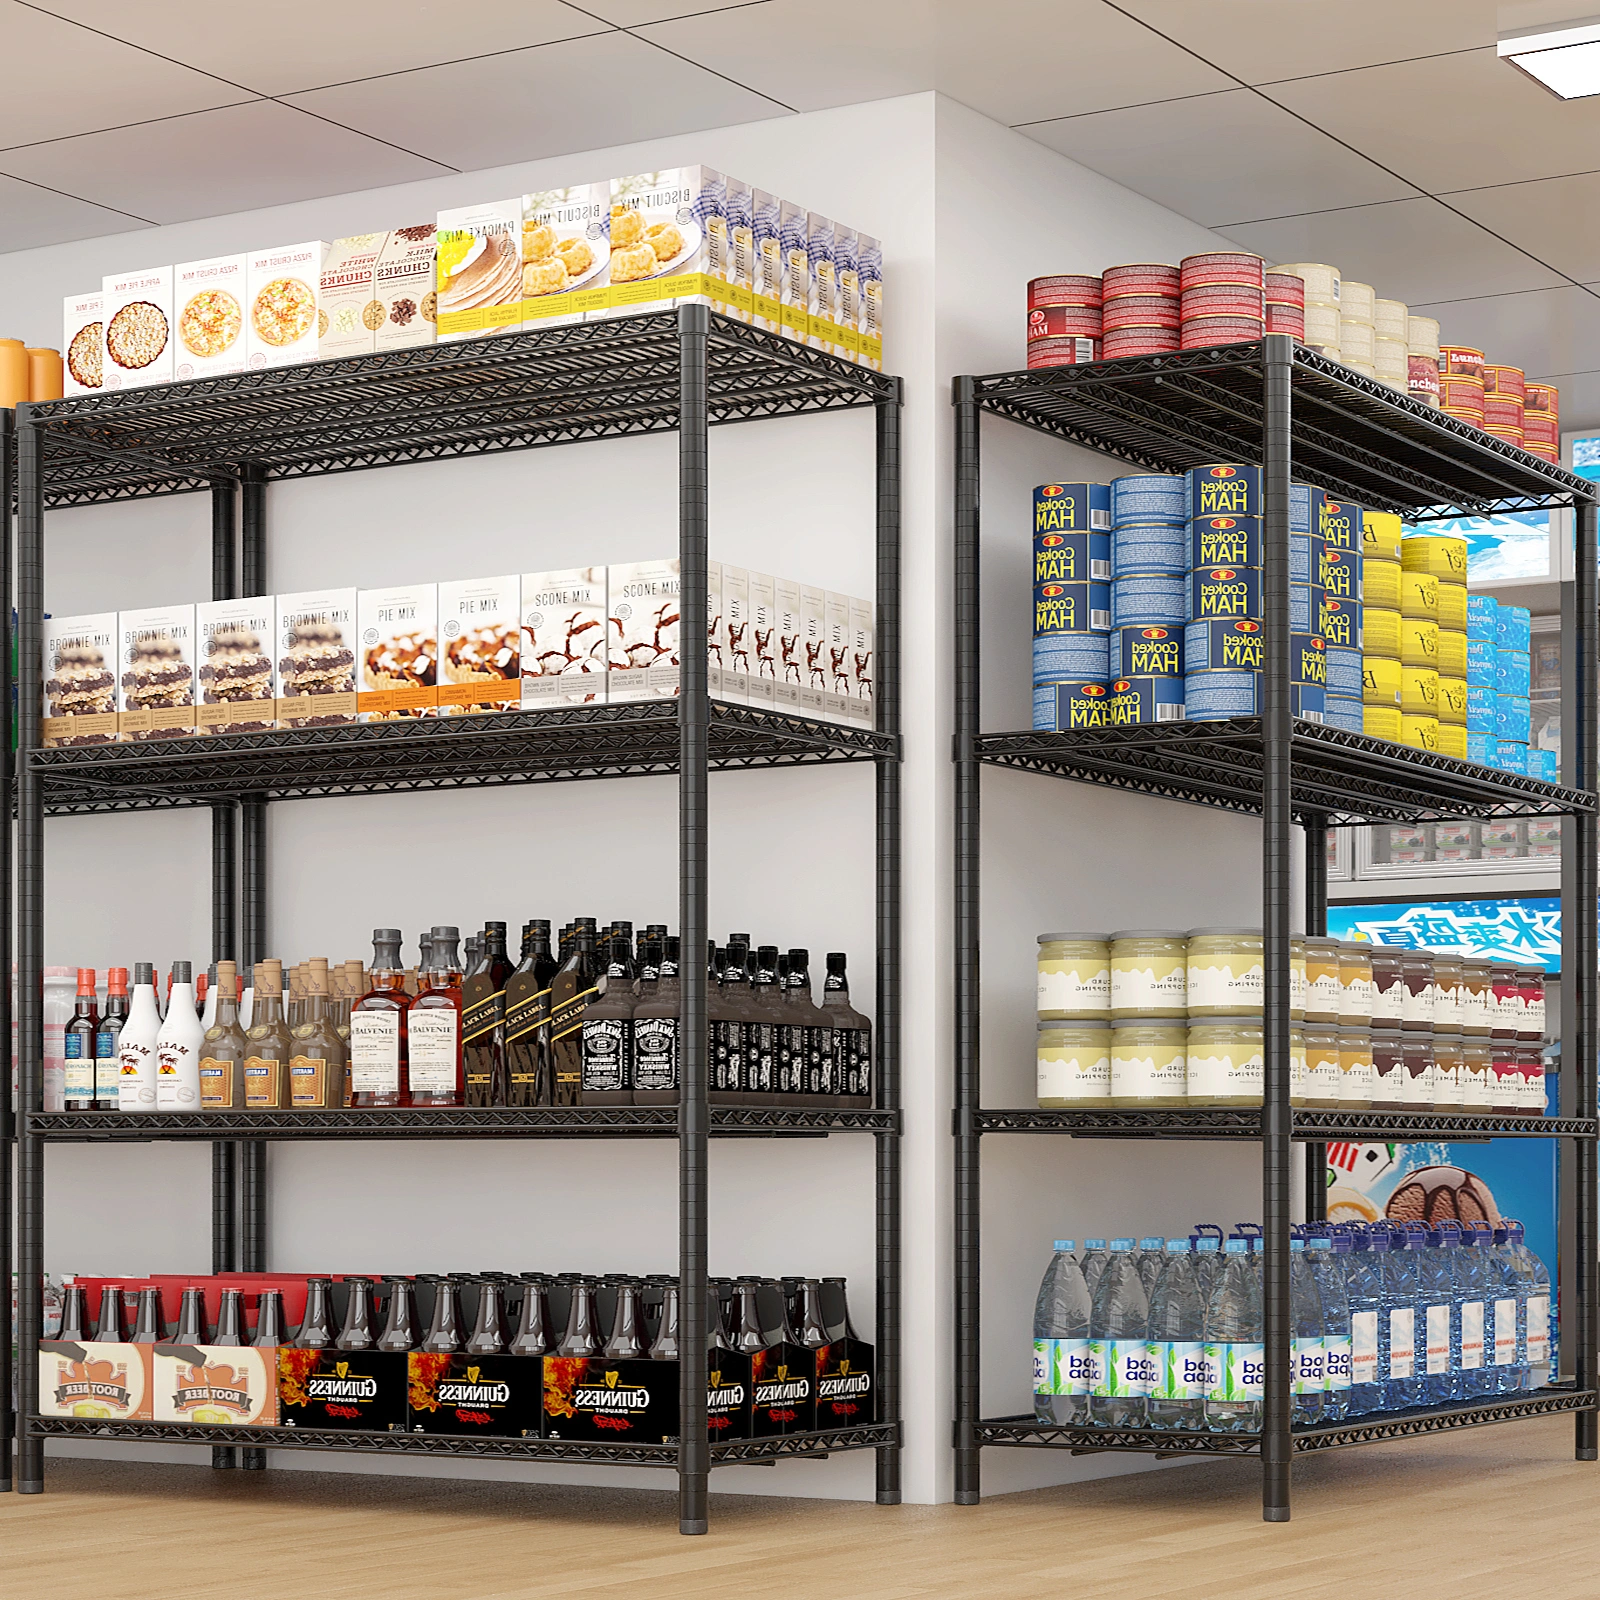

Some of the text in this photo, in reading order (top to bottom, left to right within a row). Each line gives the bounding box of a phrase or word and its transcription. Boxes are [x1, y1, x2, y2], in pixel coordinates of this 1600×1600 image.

[535, 590, 591, 607] SCONE MIX
[624, 582, 657, 598] SCONE
[378, 606, 416, 622] PIE MIX
[460, 598, 498, 615] PIE MIX
[203, 618, 267, 636] BROWNIE MIX
[282, 610, 350, 629] BROWNIE MIX
[50, 634, 110, 651] BROWNIE MIX
[125, 626, 188, 644] BROWNIE MIX
[462, 1006, 500, 1028] LACK LABEL
[506, 1004, 544, 1028] LACK LABEL
[552, 1014, 570, 1028] LACK
[356, 1027, 394, 1035] BALVENIE
